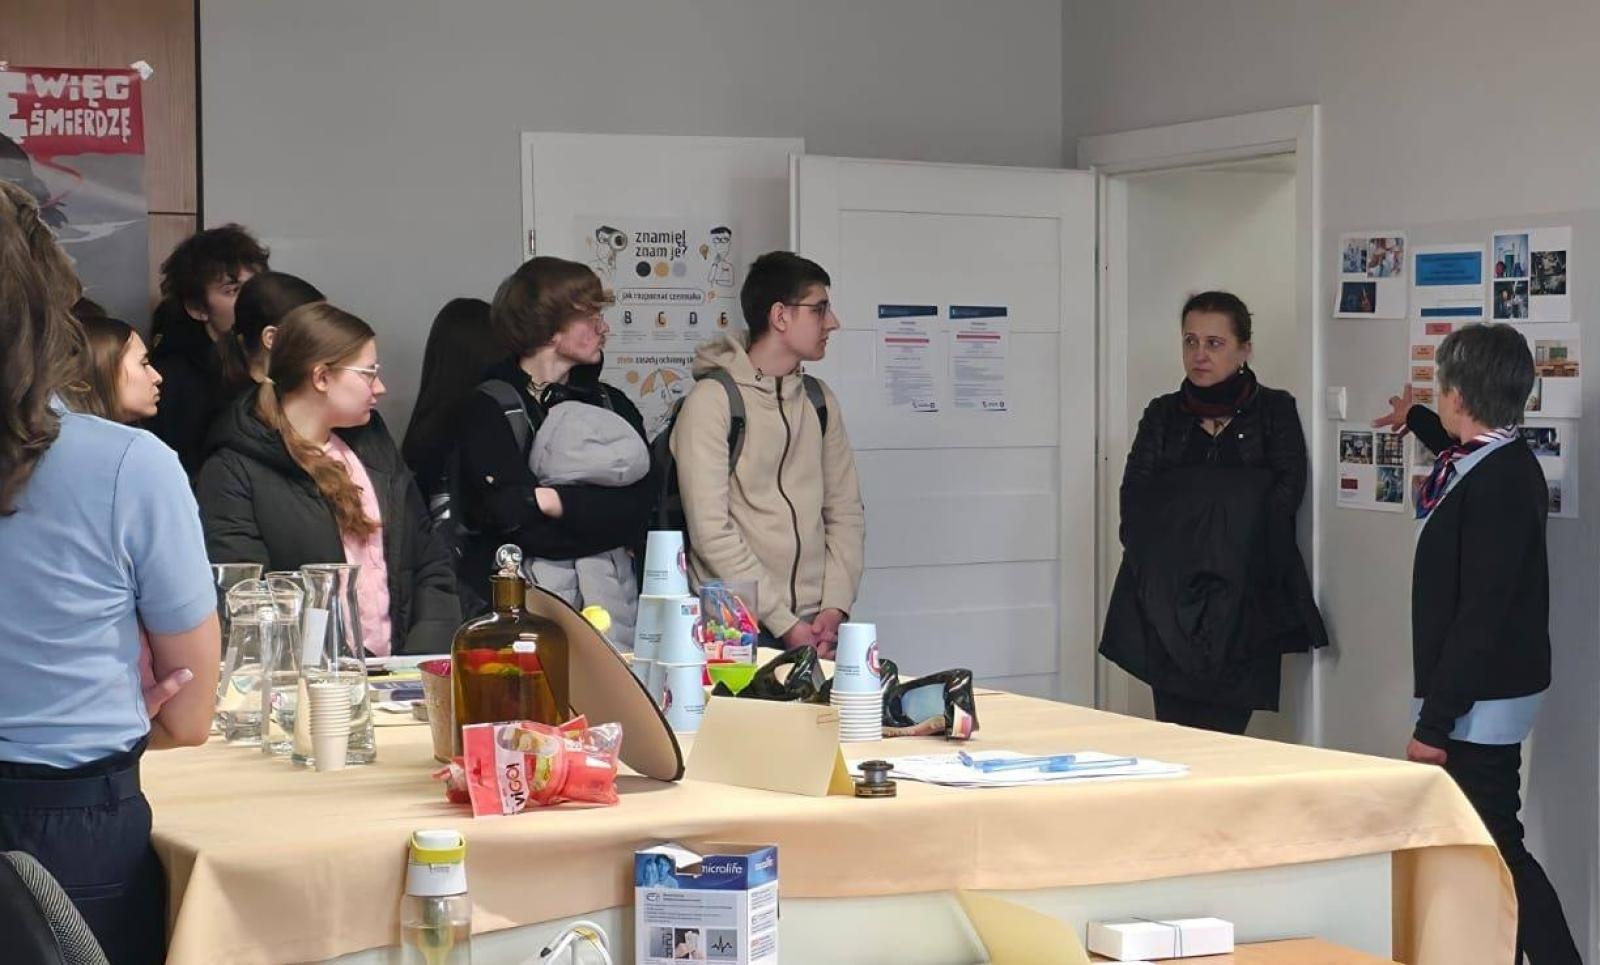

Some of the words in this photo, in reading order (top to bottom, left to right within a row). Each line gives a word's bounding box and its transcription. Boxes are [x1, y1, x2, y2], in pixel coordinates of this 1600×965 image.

[635, 246, 668, 257] znam
[624, 310, 632, 324] B
[689, 311, 698, 325] D
